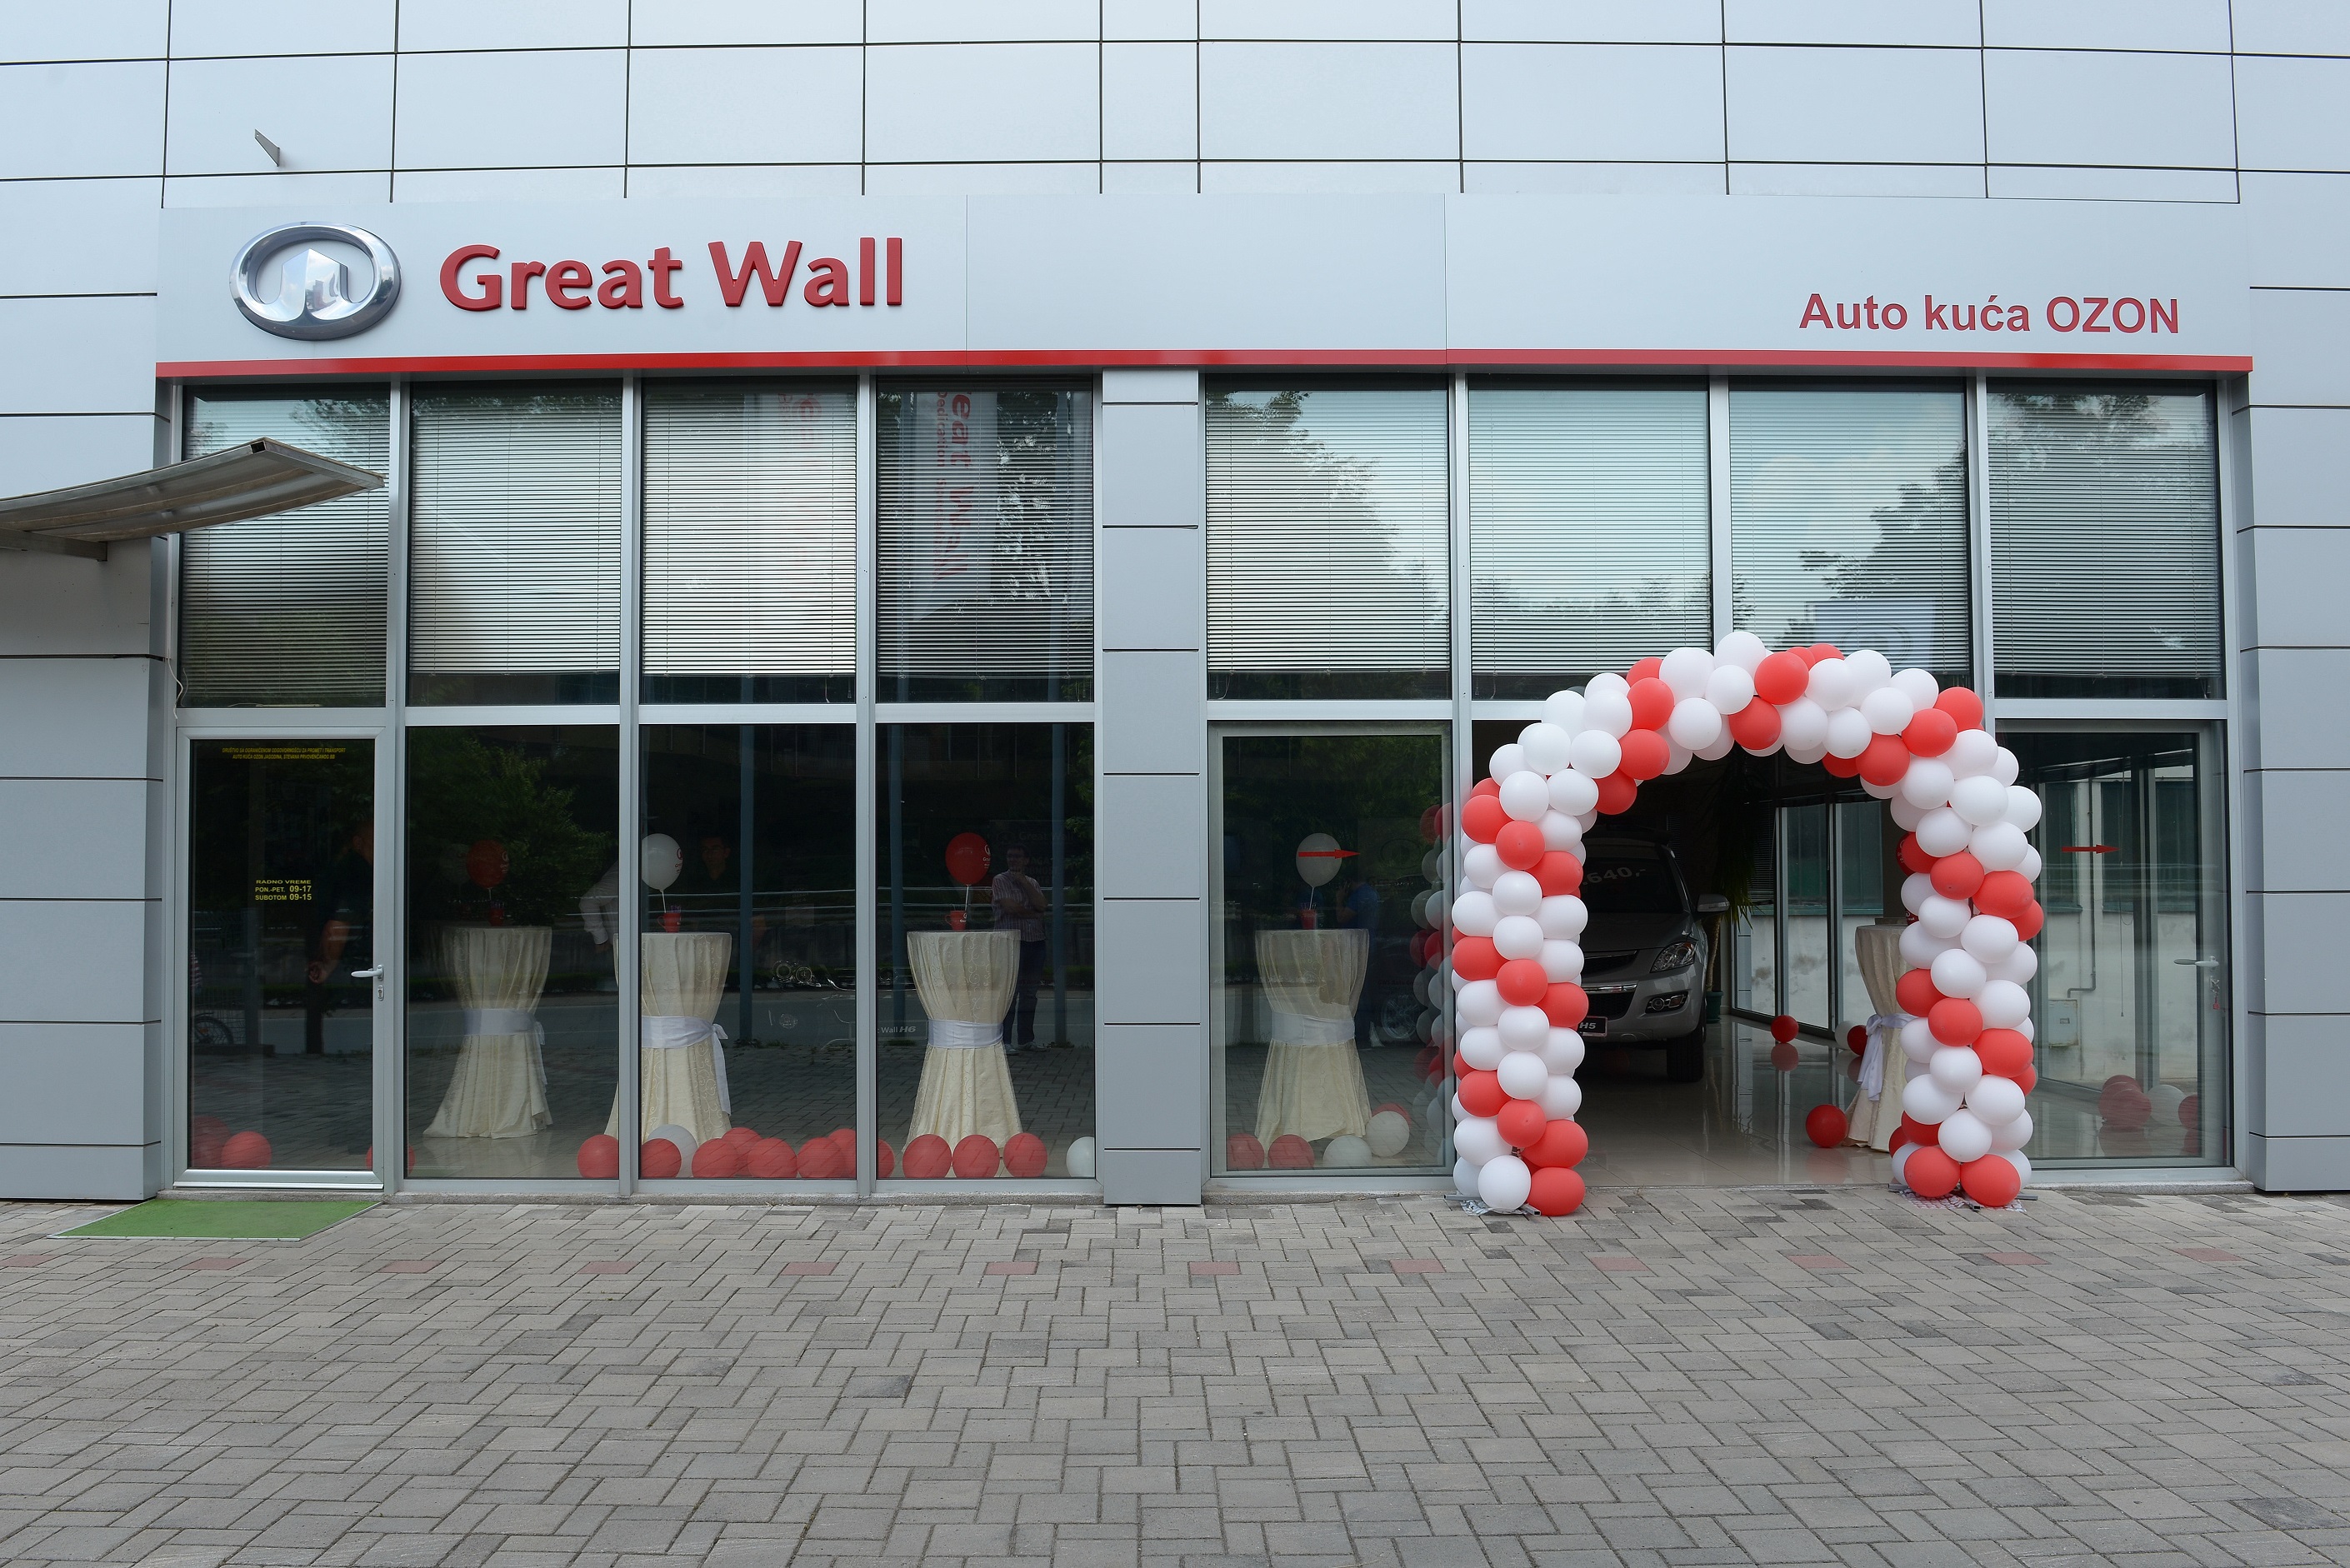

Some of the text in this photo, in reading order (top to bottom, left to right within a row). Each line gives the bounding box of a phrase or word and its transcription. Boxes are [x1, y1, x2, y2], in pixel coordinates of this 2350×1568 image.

[439, 237, 902, 312] Great Wall
[1799, 292, 2179, 334] Auto kuća OZON
[1578, 1021, 1597, 1031] H5
